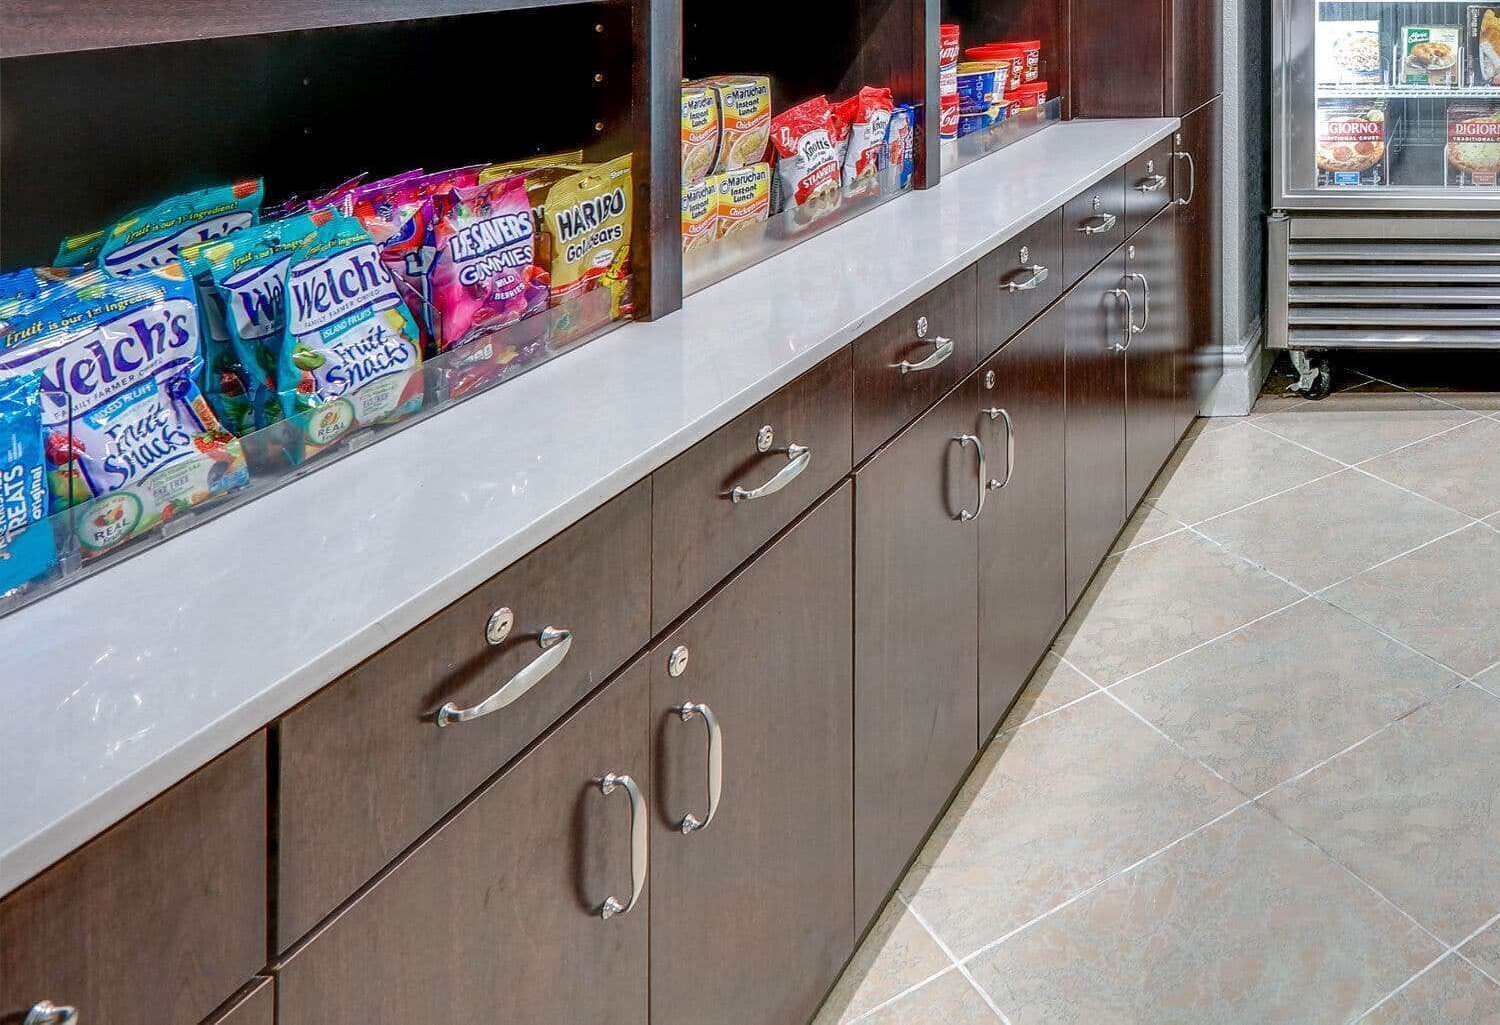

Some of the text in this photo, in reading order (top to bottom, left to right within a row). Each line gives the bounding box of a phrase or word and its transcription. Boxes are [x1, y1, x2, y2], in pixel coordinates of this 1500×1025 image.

[731, 84, 767, 99] Maruchan
[735, 99, 759, 108] Instant
[803, 137, 831, 161] Knott's
[728, 171, 766, 187] Maruchan
[730, 184, 757, 196] Instant
[556, 187, 625, 243] HARIBO
[293, 251, 392, 322] Welch's
[6, 319, 44, 347] Fruit
[61, 313, 84, 327] our
[333, 325, 389, 367] Fruit
[326, 343, 409, 395] Snacks
[94, 375, 137, 399] FARMER
[5, 464, 28, 543] TREATS
[31, 465, 46, 520] original
[94, 519, 130, 541] REAL
